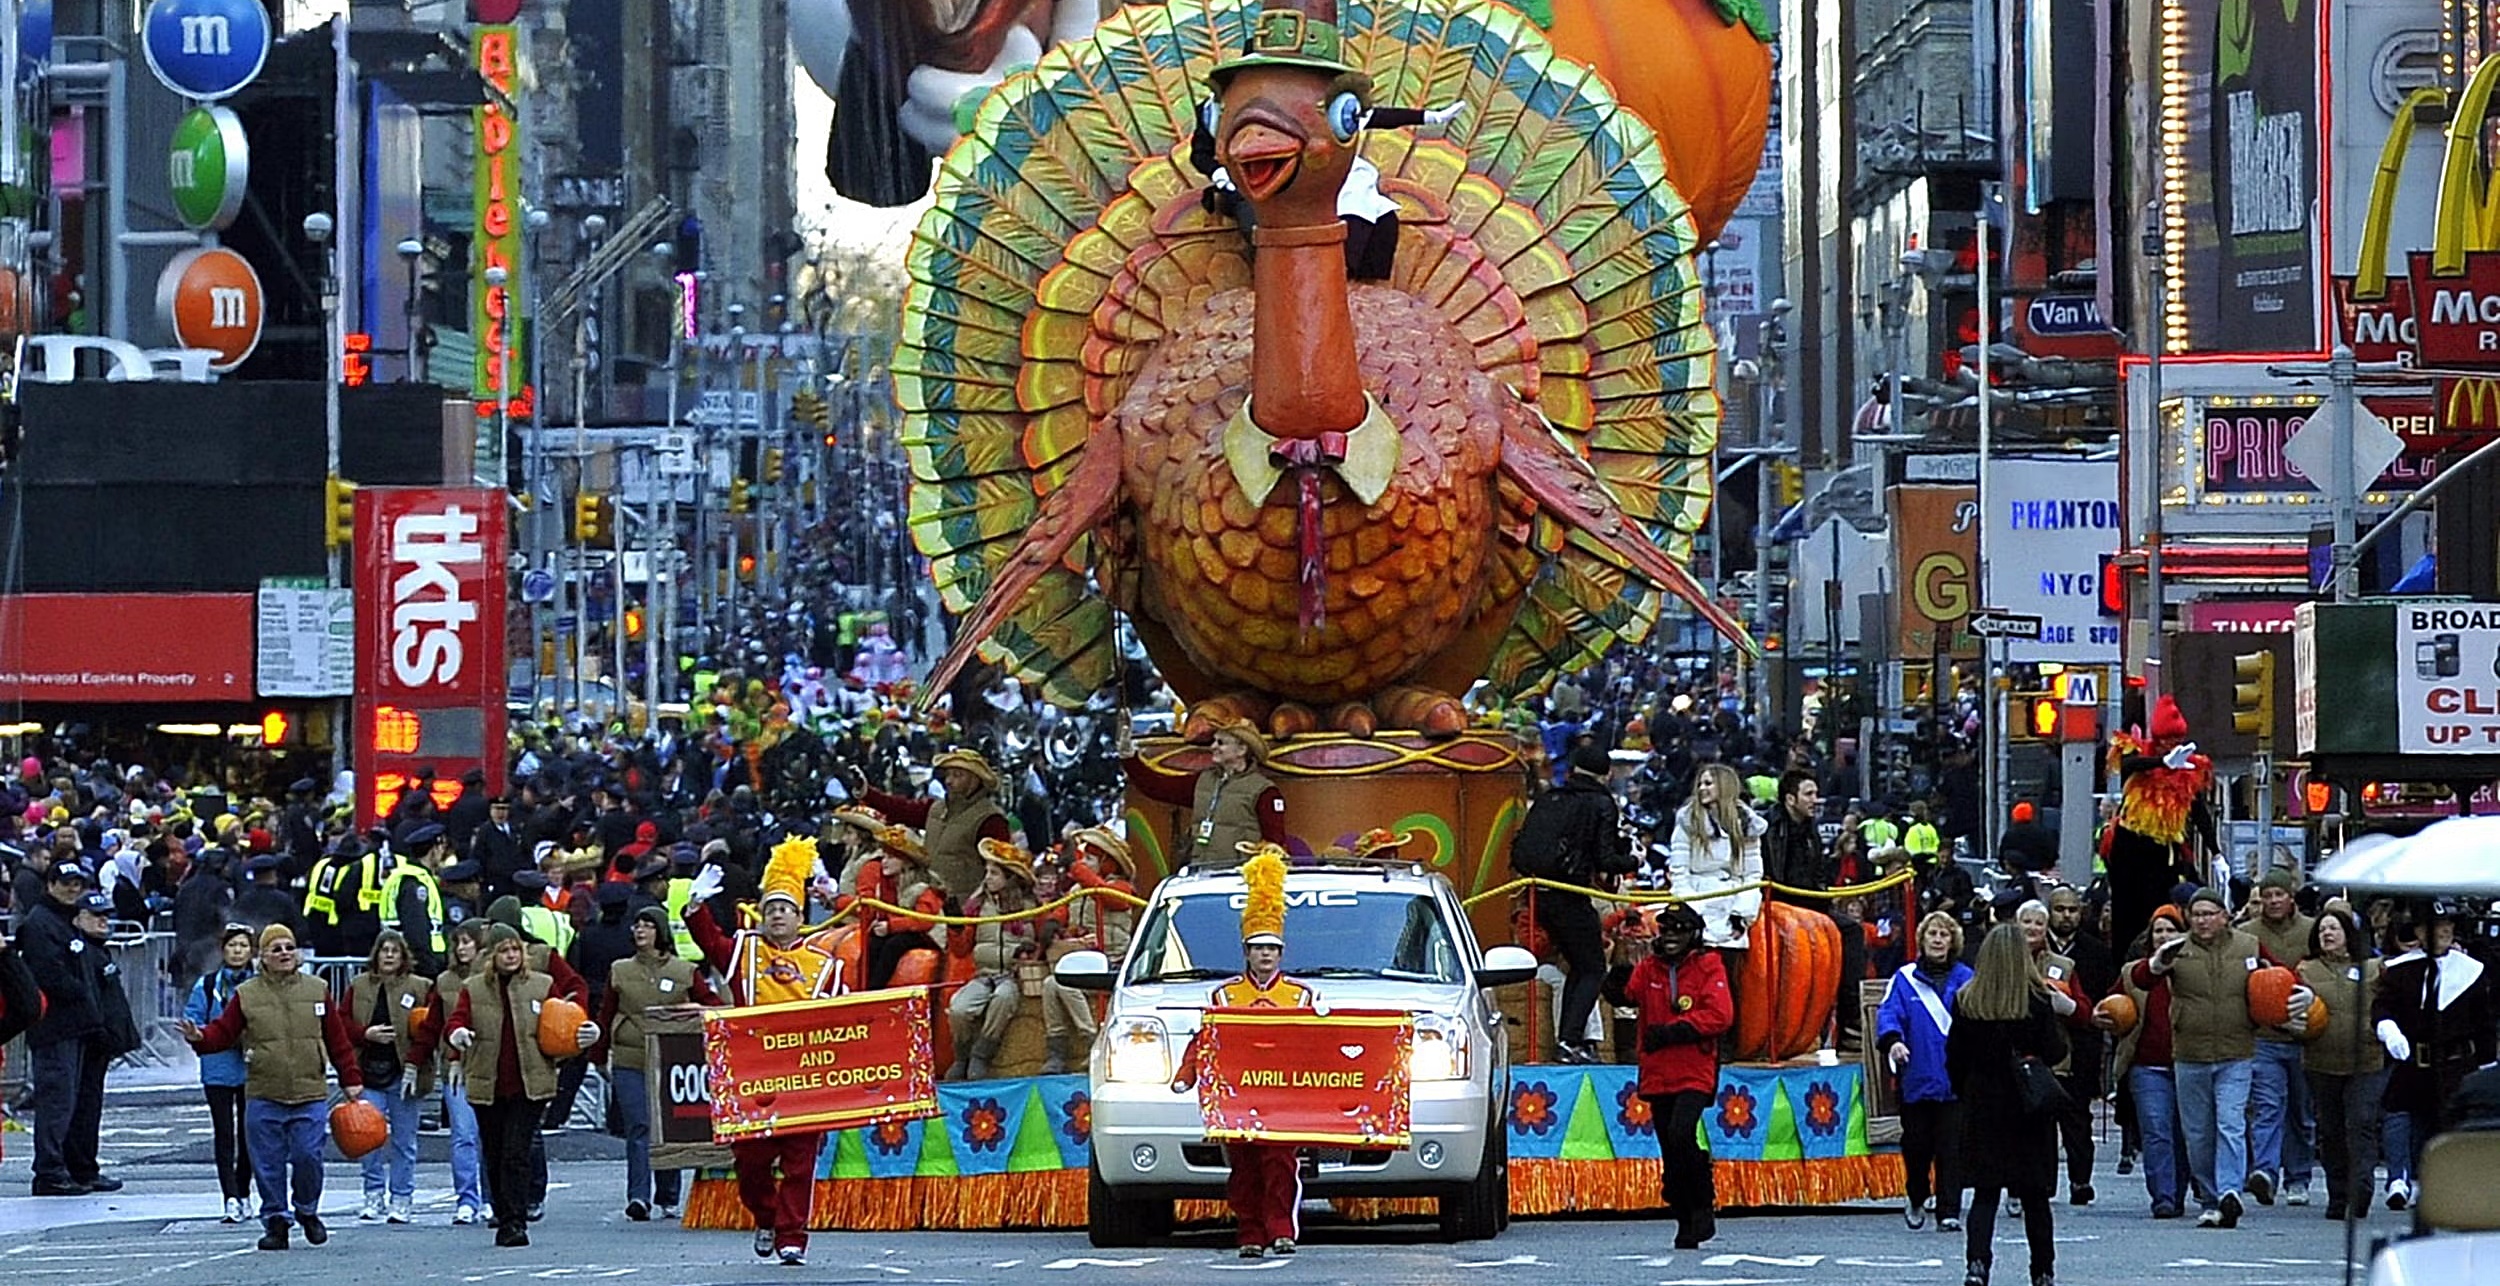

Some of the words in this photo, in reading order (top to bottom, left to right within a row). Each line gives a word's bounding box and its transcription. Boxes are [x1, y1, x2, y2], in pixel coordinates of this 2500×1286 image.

[181, 15, 231, 55] m
[209, 286, 247, 329] m
[2041, 302, 2079, 325] Van
[393, 505, 483, 688] tkts
[1914, 553, 1970, 622] G
[2041, 573, 2094, 595] NYC
[2426, 688, 2500, 715] CL
[2426, 726, 2471, 744] UP
[763, 1033, 804, 1051] DEBI
[808, 1025, 869, 1045] MAZAR
[799, 1050, 835, 1068] AND
[739, 1073, 822, 1097] GABRIELE
[826, 1063, 902, 1086] CORCOS
[1240, 1070, 1288, 1087] AVRIL
[1293, 1072, 1364, 1088] LAVIGNE
